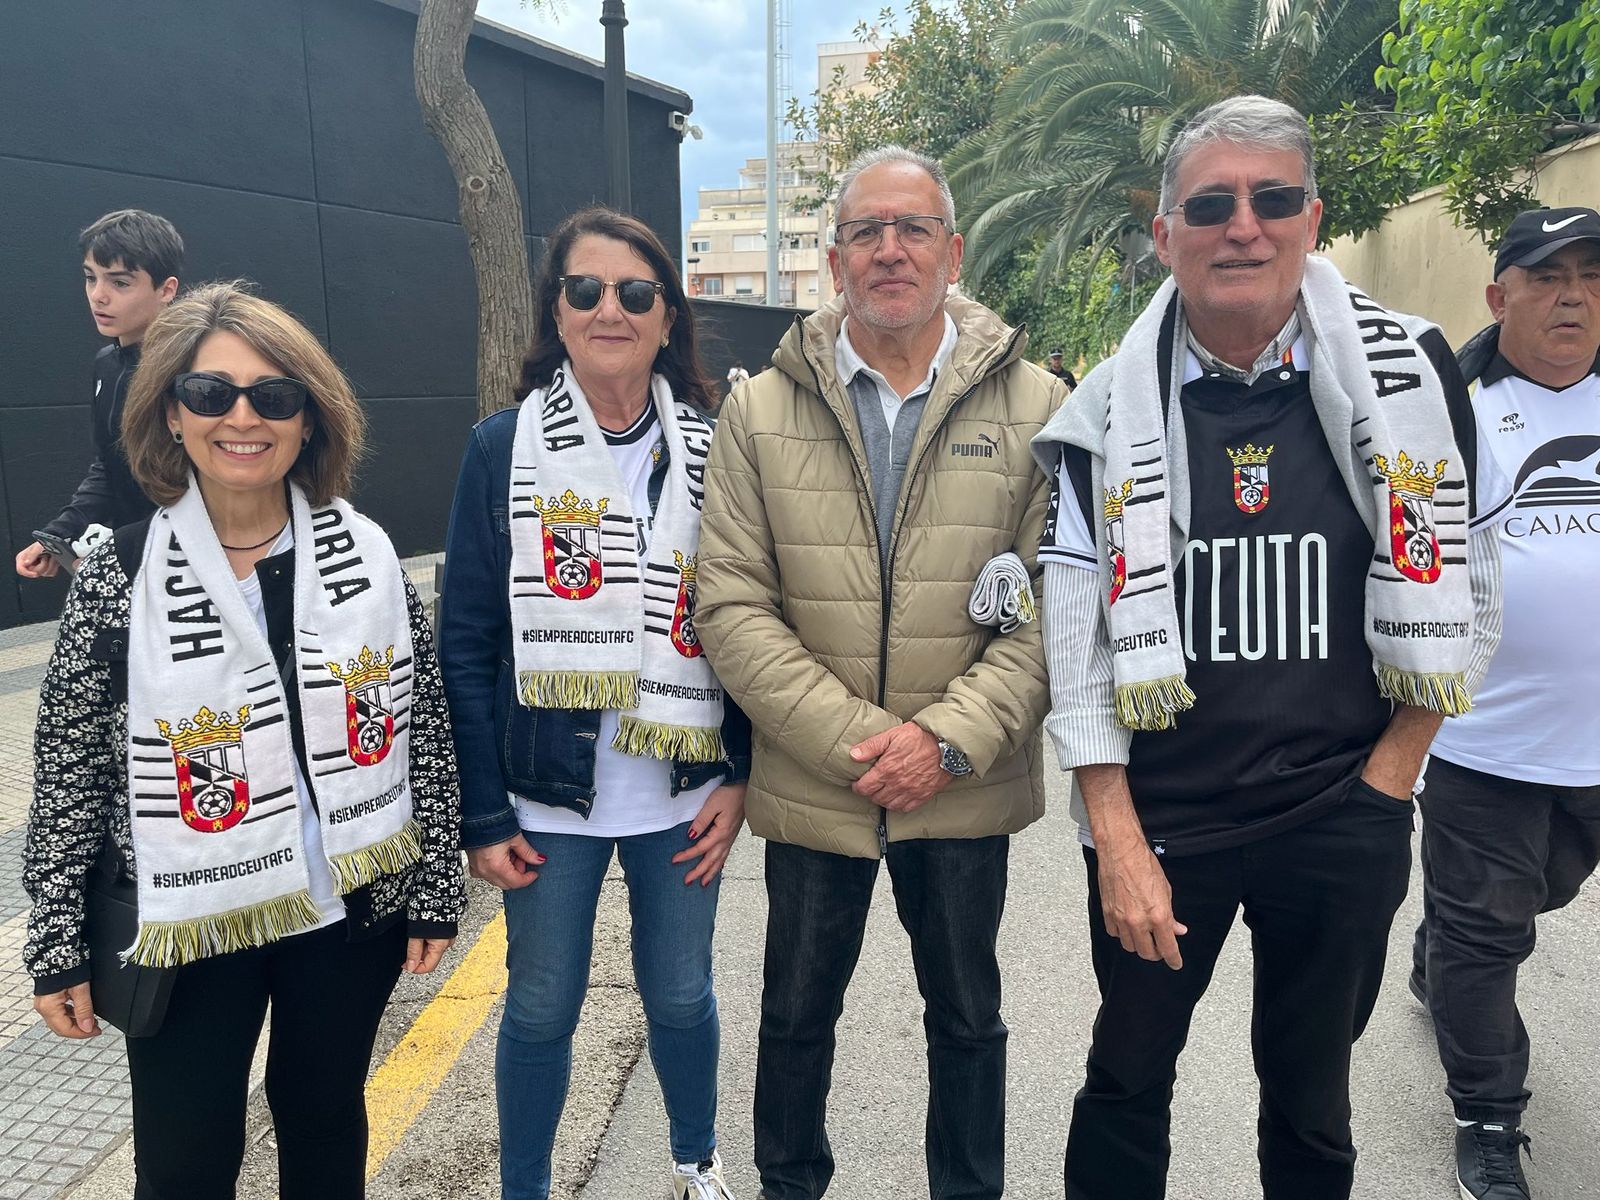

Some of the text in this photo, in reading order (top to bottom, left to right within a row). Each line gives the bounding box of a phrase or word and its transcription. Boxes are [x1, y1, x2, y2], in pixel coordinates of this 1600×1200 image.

[1498, 421, 1525, 433] ressy
[951, 443, 993, 458] PUMA
[1184, 532, 1328, 662] CEUTA
[521, 629, 634, 644] #SIEMPREADCEUTAFC
[152, 848, 294, 889] #SIEMPREADCEUTAFC
